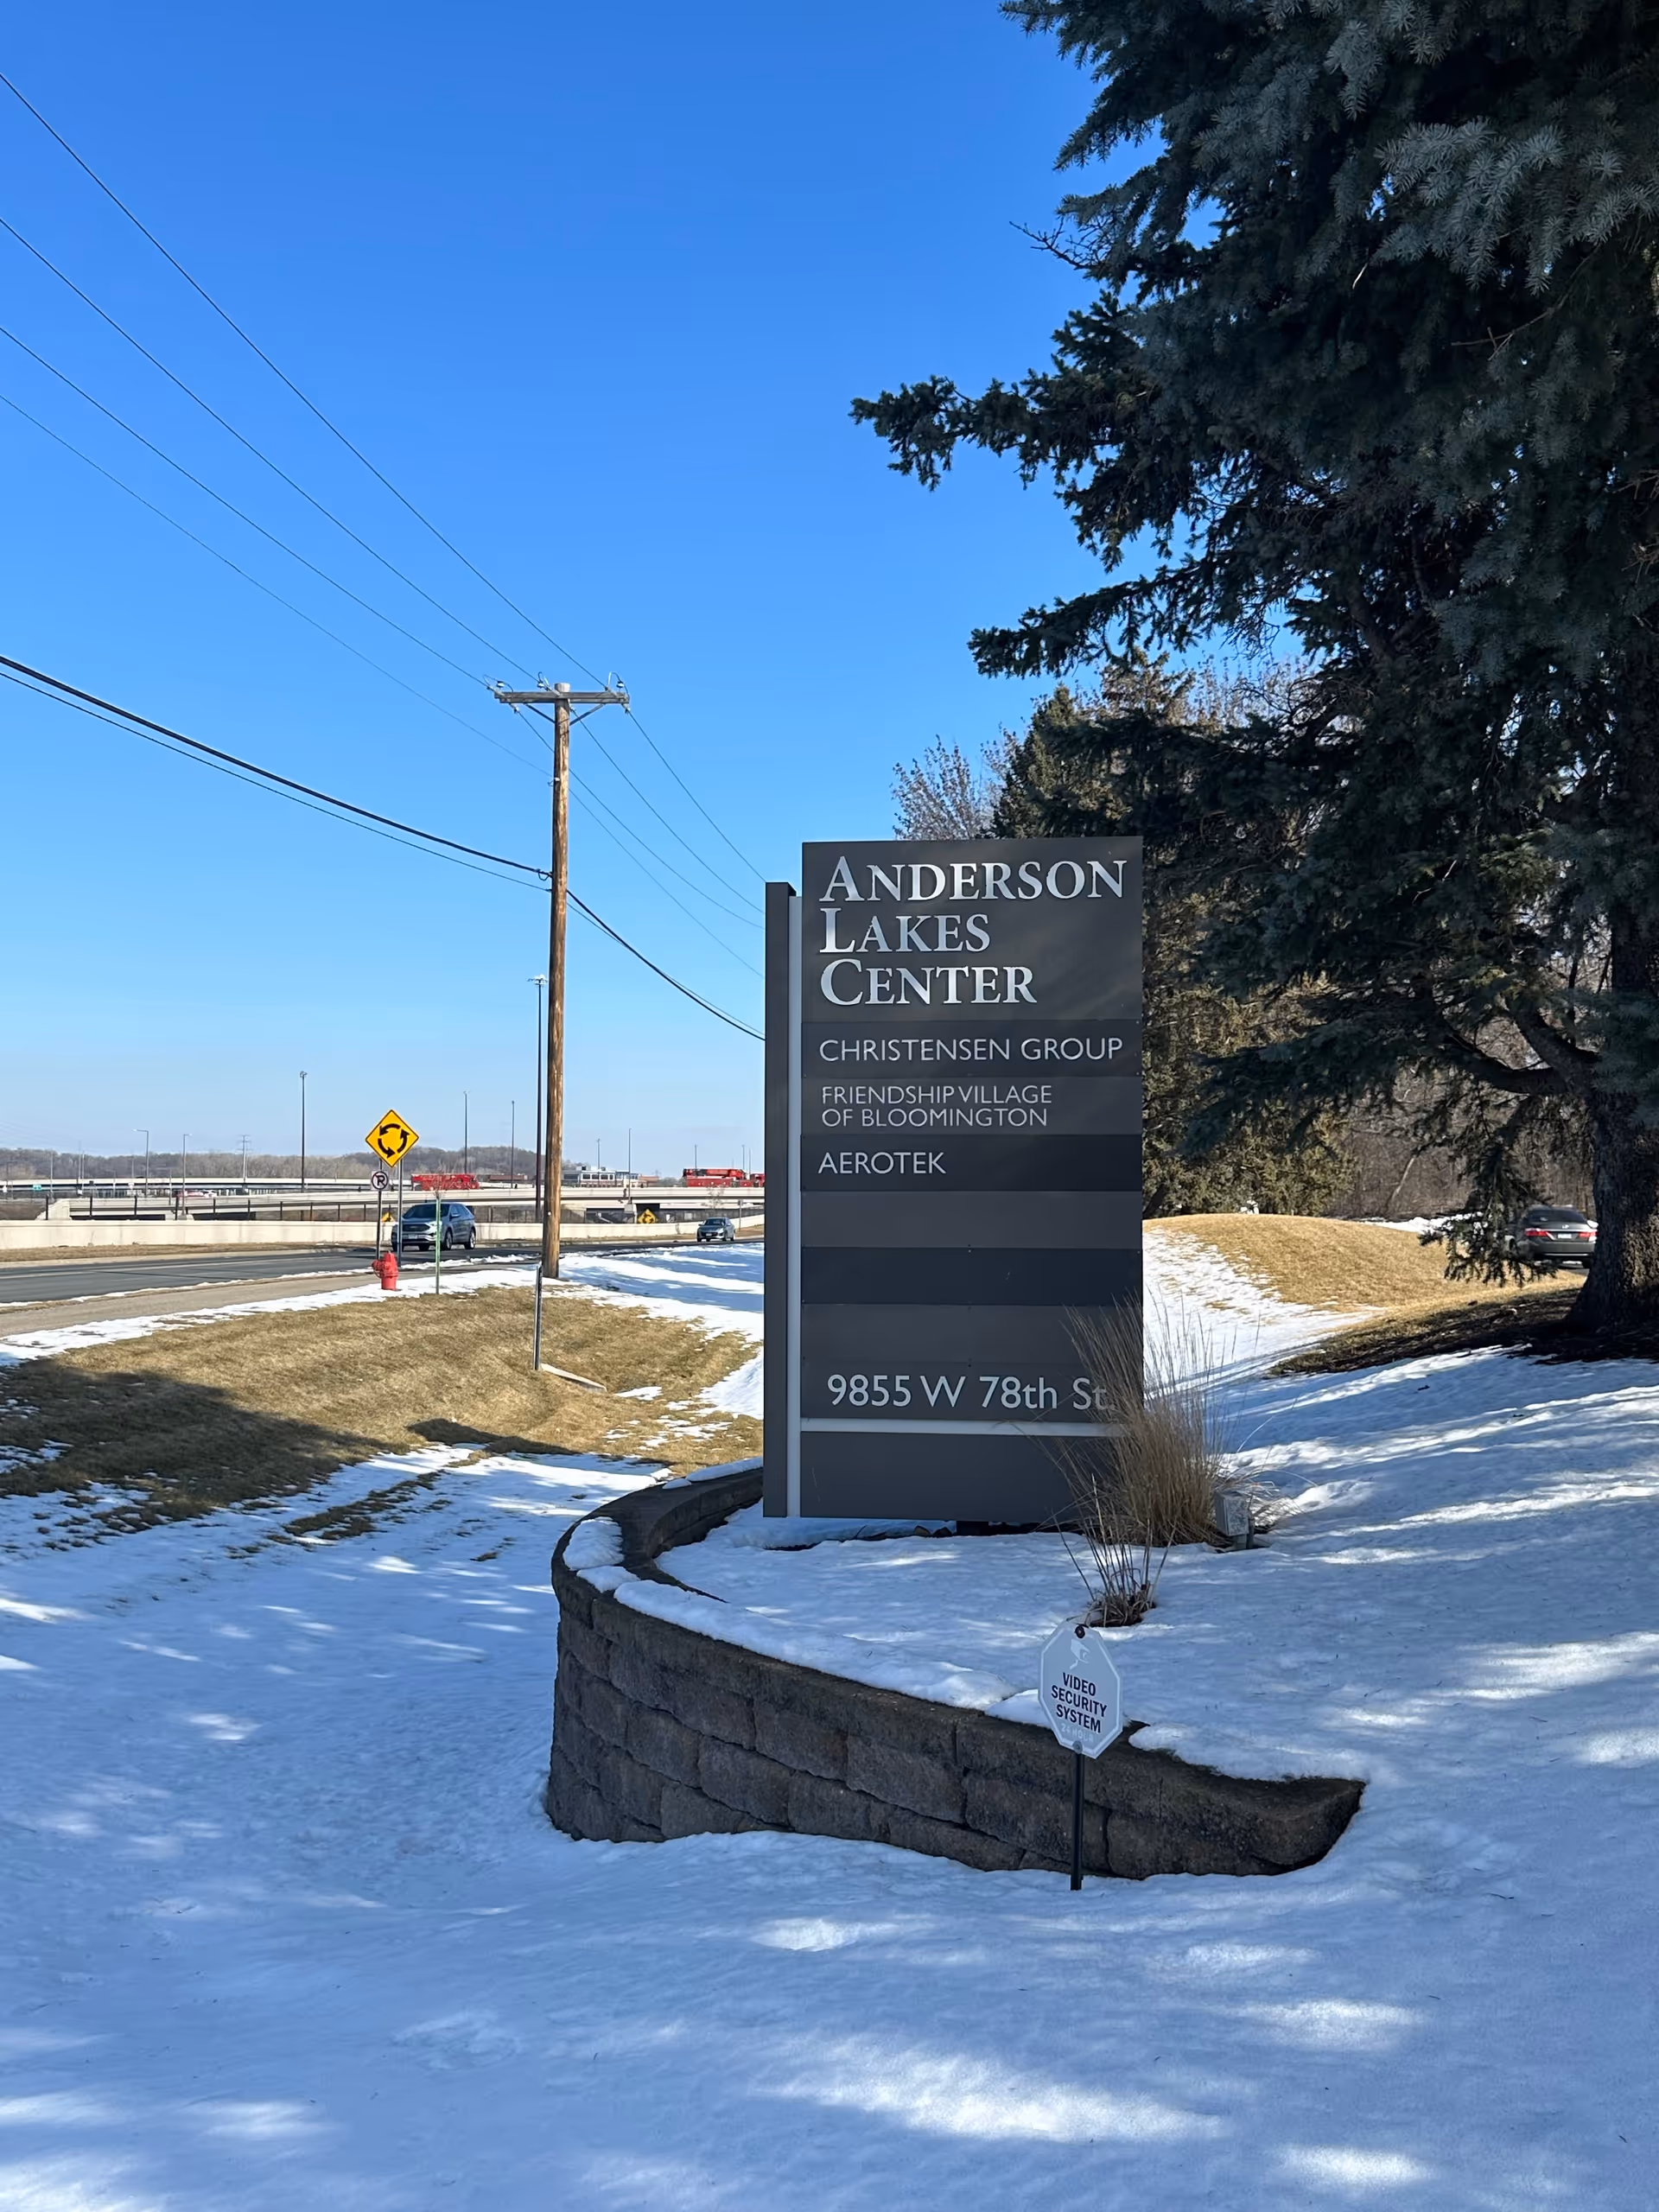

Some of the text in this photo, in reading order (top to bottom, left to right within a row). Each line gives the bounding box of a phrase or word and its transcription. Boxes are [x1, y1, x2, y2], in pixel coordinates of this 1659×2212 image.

[818, 855, 1128, 902] ANDERSON
[819, 907, 991, 953] LAKES
[820, 958, 1038, 1006] CENTER
[819, 1037, 1123, 1062] CHRISTENSEN GROUP
[822, 1084, 1052, 1104] FRIENDSHIP VILLAGE
[821, 1107, 1048, 1128] OF BLOOMINGTON
[817, 1152, 947, 1174] AEROTEK
[827, 1374, 912, 1407] 9855
[919, 1375, 966, 1408] W
[979, 1376, 1058, 1409] 78th
[1062, 1671, 1096, 1697] VIDEO
[1051, 1684, 1108, 1718] SECURITY
[1056, 1704, 1102, 1733] SYSTEM
